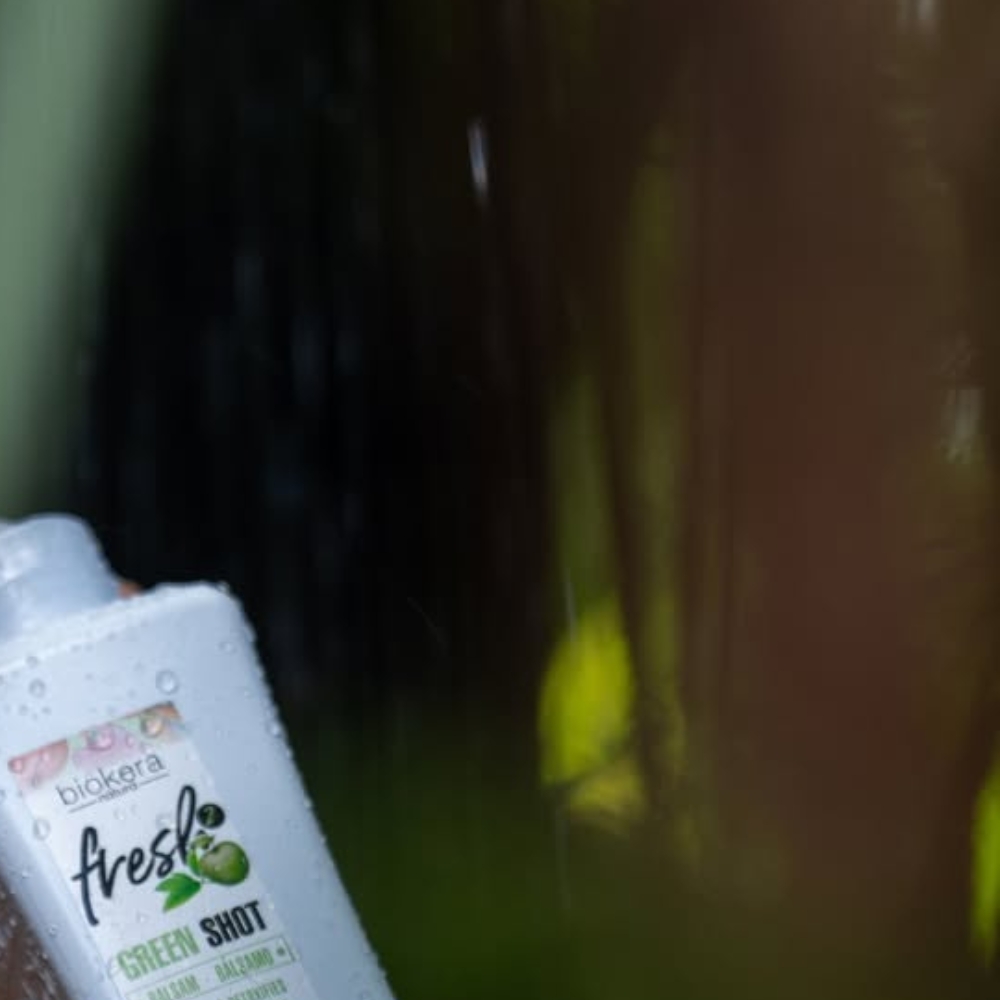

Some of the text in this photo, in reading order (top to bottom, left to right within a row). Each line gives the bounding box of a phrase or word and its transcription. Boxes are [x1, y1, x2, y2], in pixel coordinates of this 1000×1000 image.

[56, 753, 165, 805] biokera
[117, 900, 267, 980] GREEN SHOT
